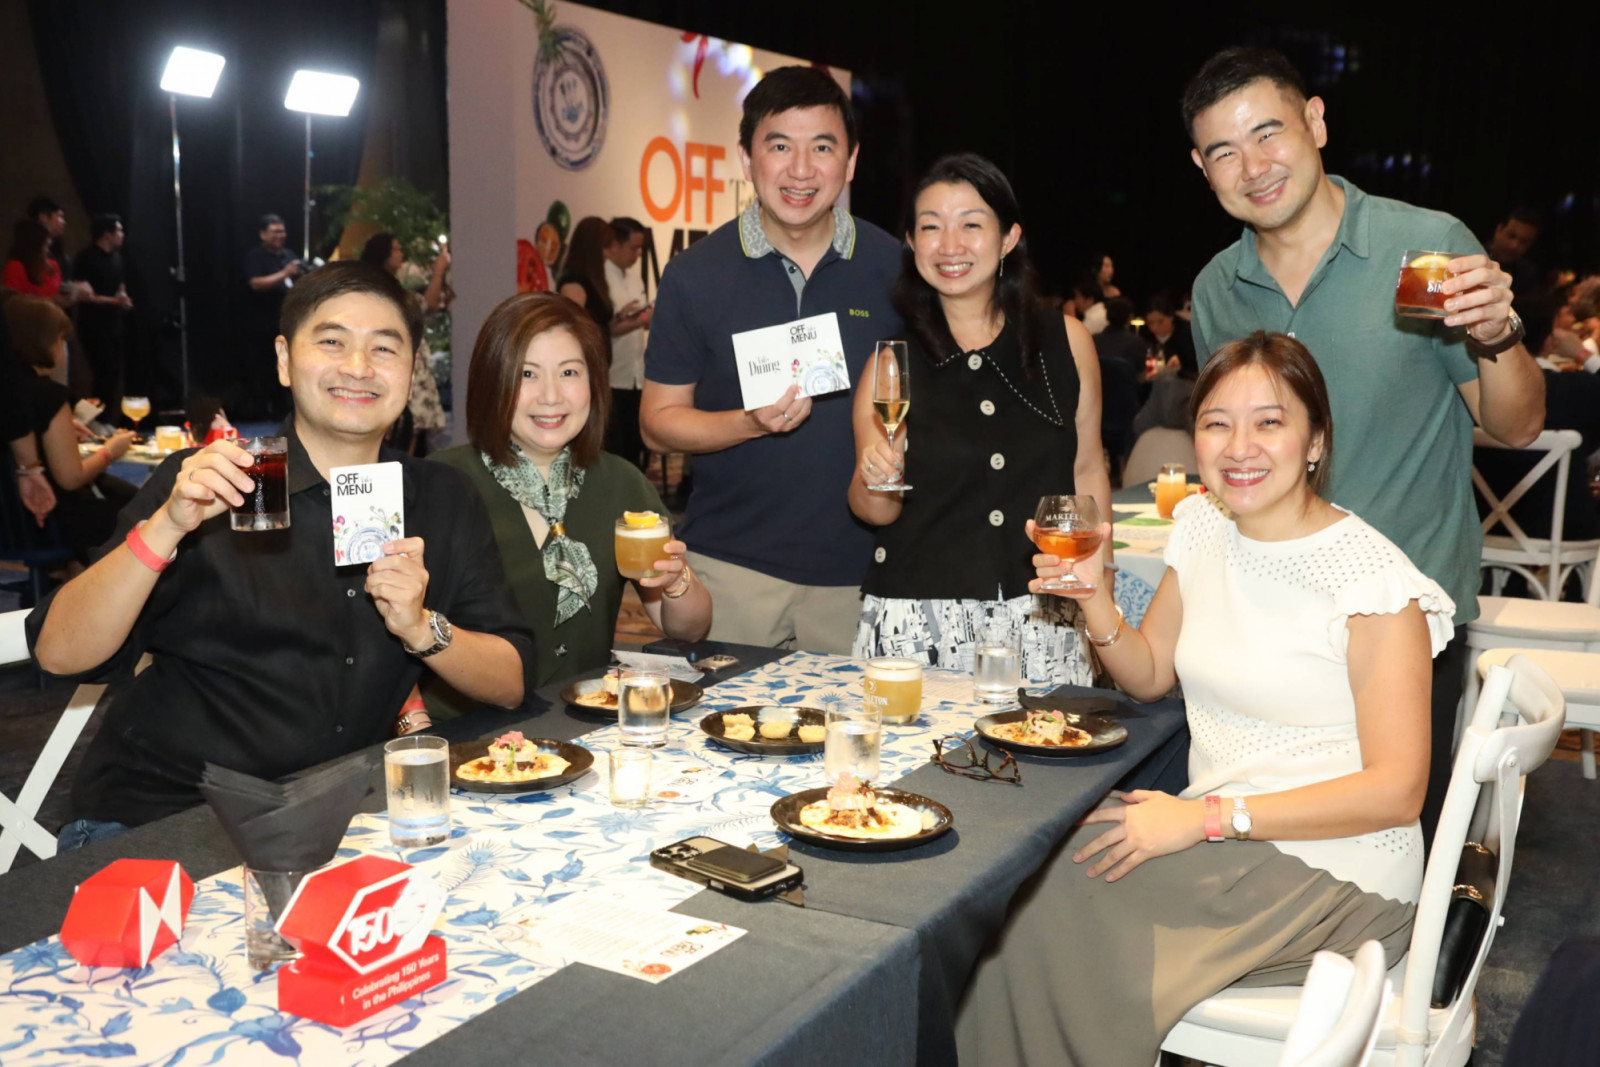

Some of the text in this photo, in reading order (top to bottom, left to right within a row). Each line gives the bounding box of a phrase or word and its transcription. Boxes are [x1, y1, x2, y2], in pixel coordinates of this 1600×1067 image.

[639, 136, 726, 224] OFF
[849, 309, 870, 318] BOSS
[790, 324, 806, 336] OFF
[791, 331, 818, 345] MENU
[336, 473, 359, 485] OFF
[337, 483, 373, 496] MENU
[347, 906, 394, 955] 150
[352, 953, 439, 999] Celebrating 150 Years
[362, 971, 431, 1010] in the Philippines
